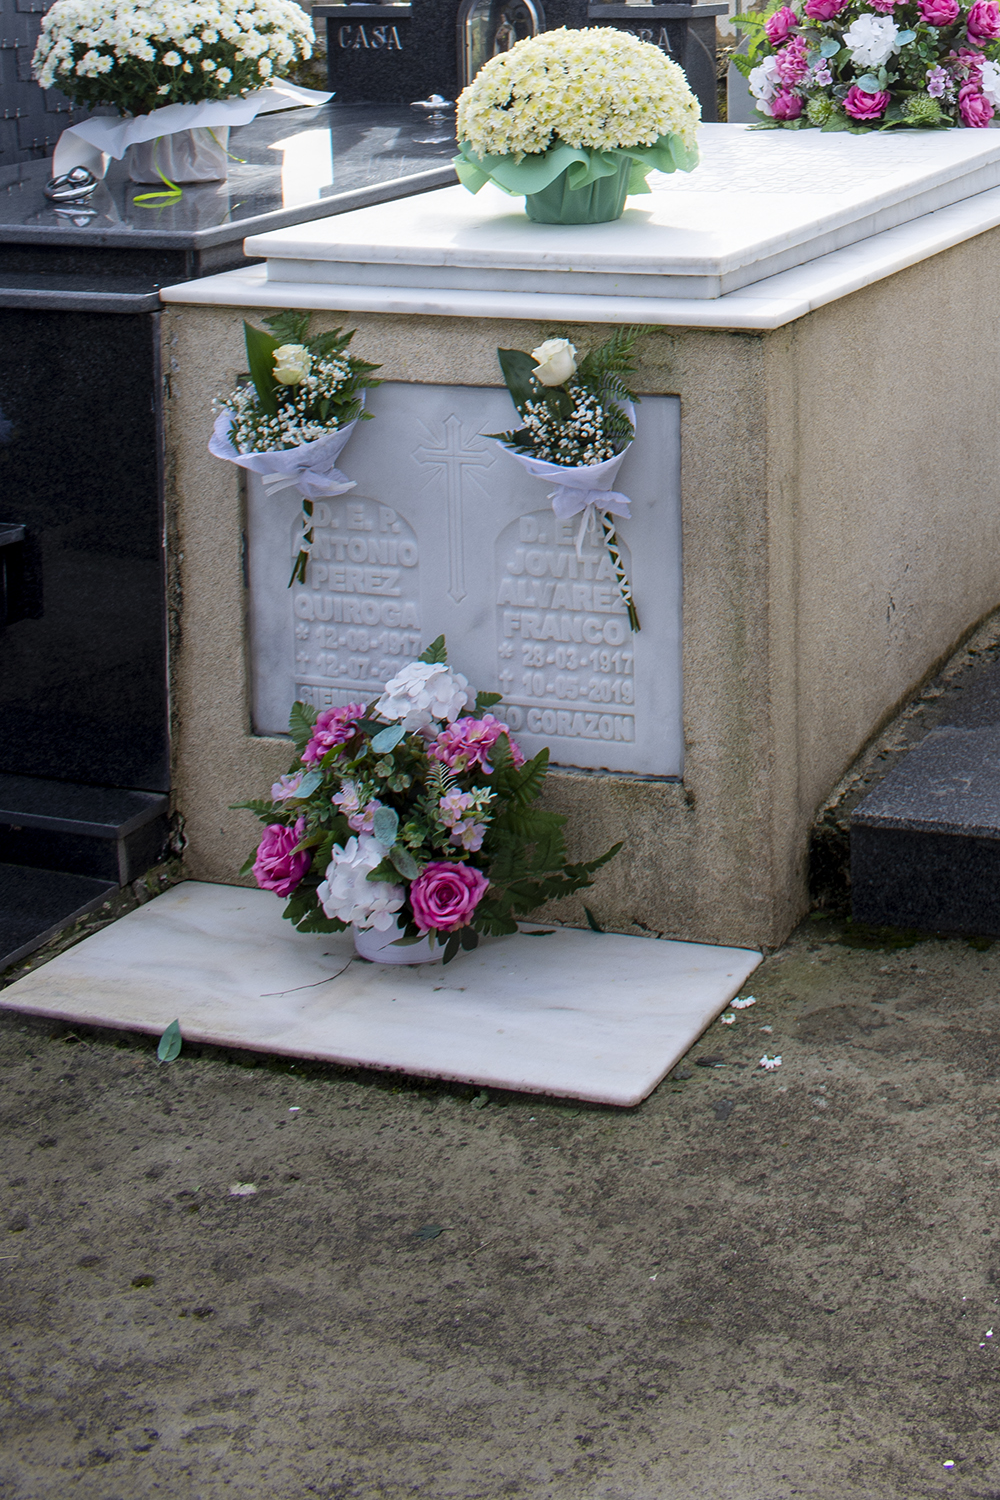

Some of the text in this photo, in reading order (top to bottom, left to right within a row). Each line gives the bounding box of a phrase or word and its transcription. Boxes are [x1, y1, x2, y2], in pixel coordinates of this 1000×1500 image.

[338, 24, 403, 50] CASA
[311, 562, 401, 597] PEREZ
[506, 547, 622, 582] JOVITA
[293, 592, 421, 630] QUIROGA
[503, 610, 625, 647] FRANCO
[522, 641, 634, 675] 28-03-1917
[522, 669, 634, 705] 10-05-2019
[526, 706, 635, 742] CORAZON
